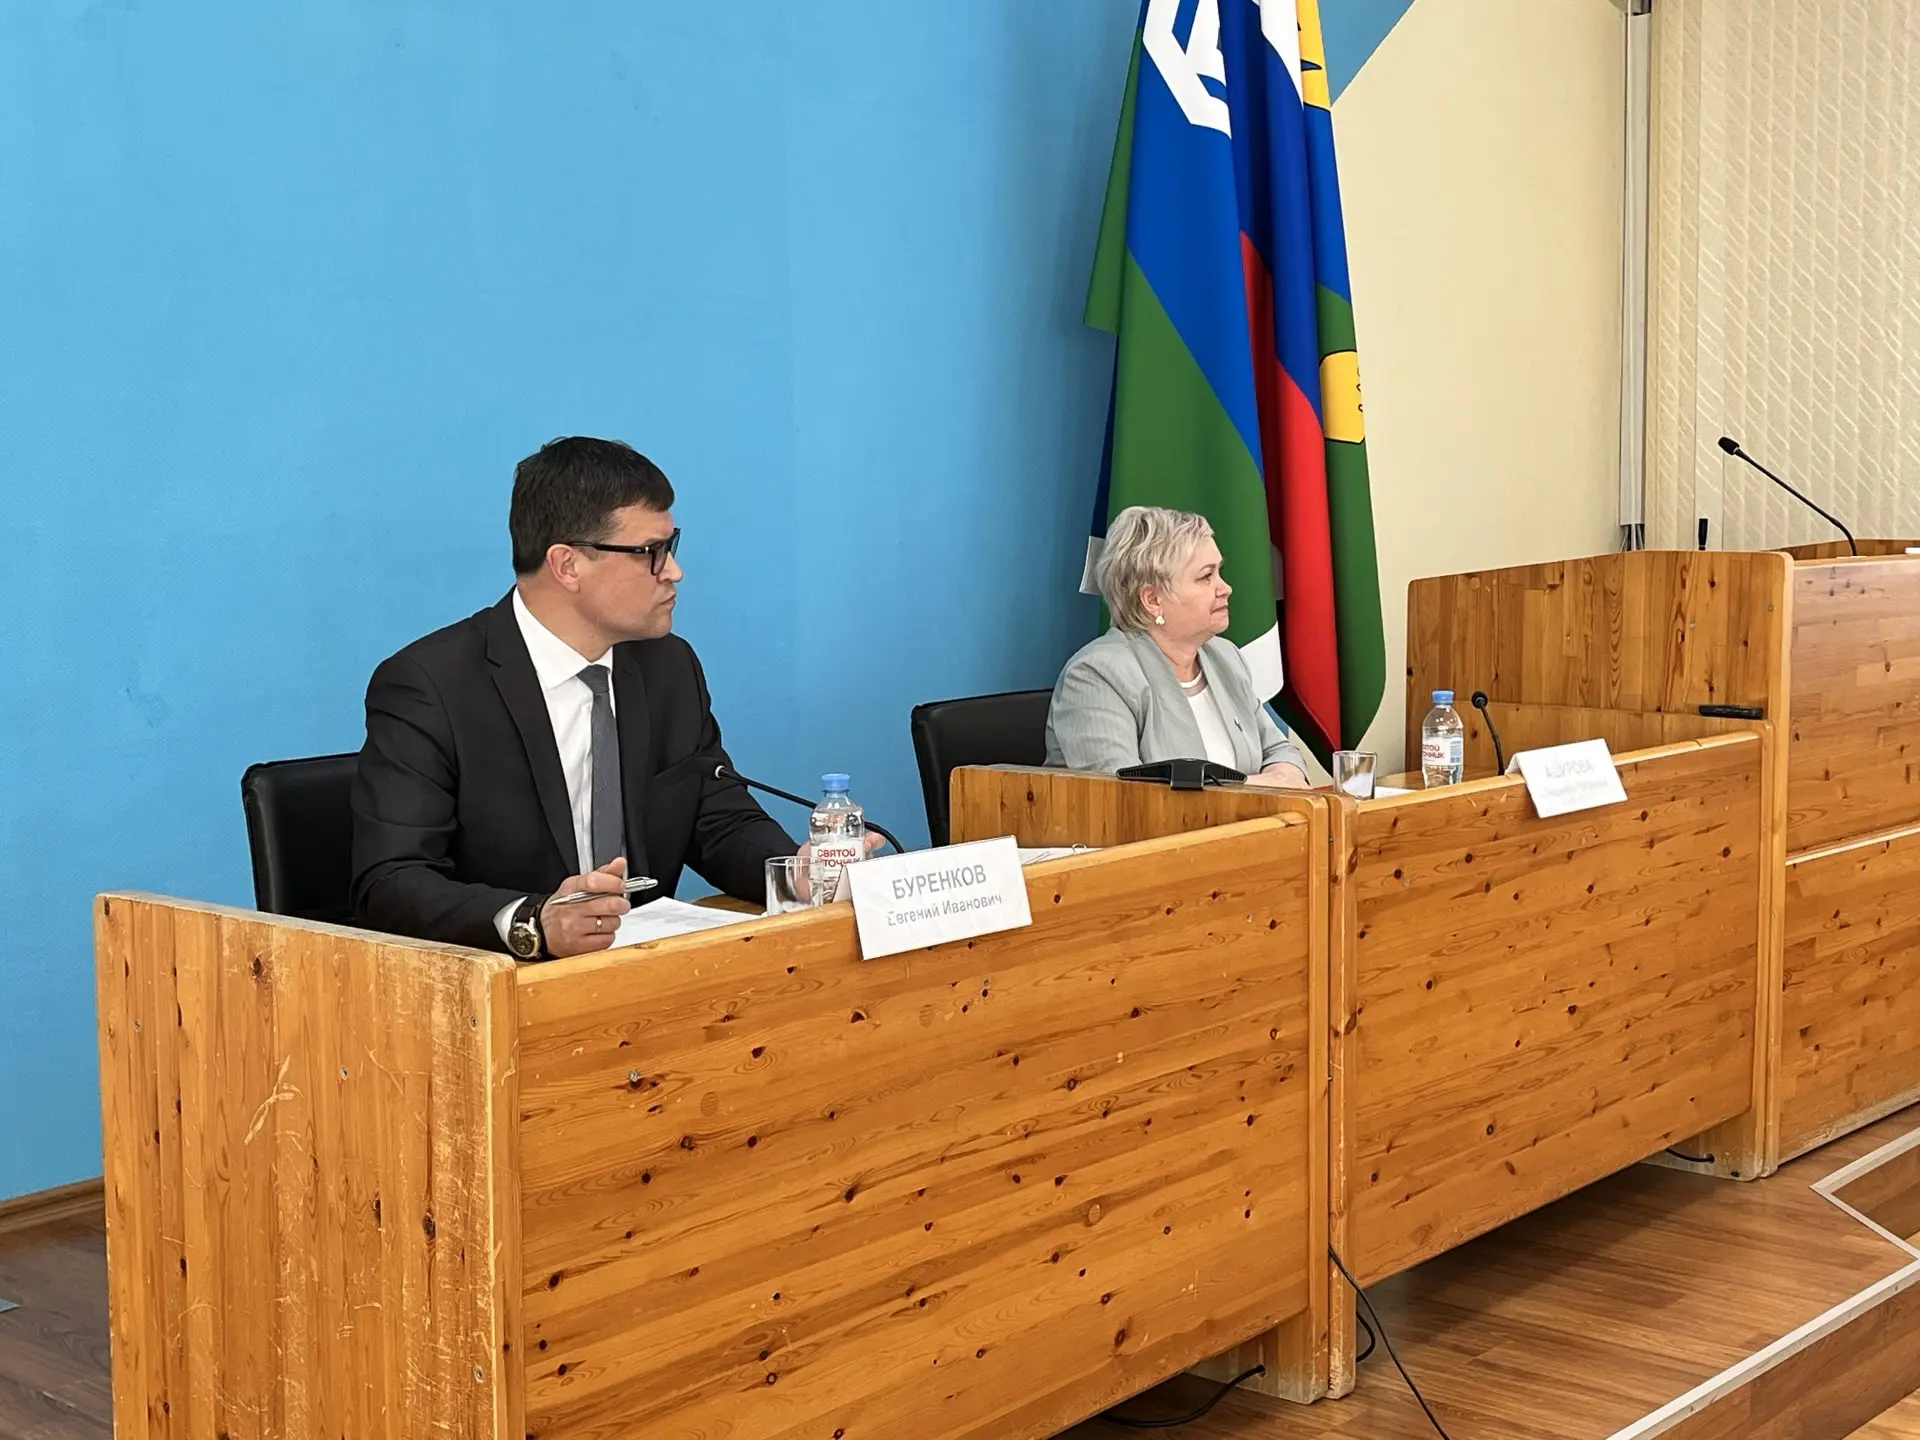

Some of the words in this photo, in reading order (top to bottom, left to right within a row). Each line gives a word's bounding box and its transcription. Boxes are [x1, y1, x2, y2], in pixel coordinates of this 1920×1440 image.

[817, 847, 856, 858] СВЯТОЙ
[892, 864, 987, 900] БУРЕНКОВ
[887, 903, 940, 926] Евгений
[942, 894, 1002, 915] Иванович
